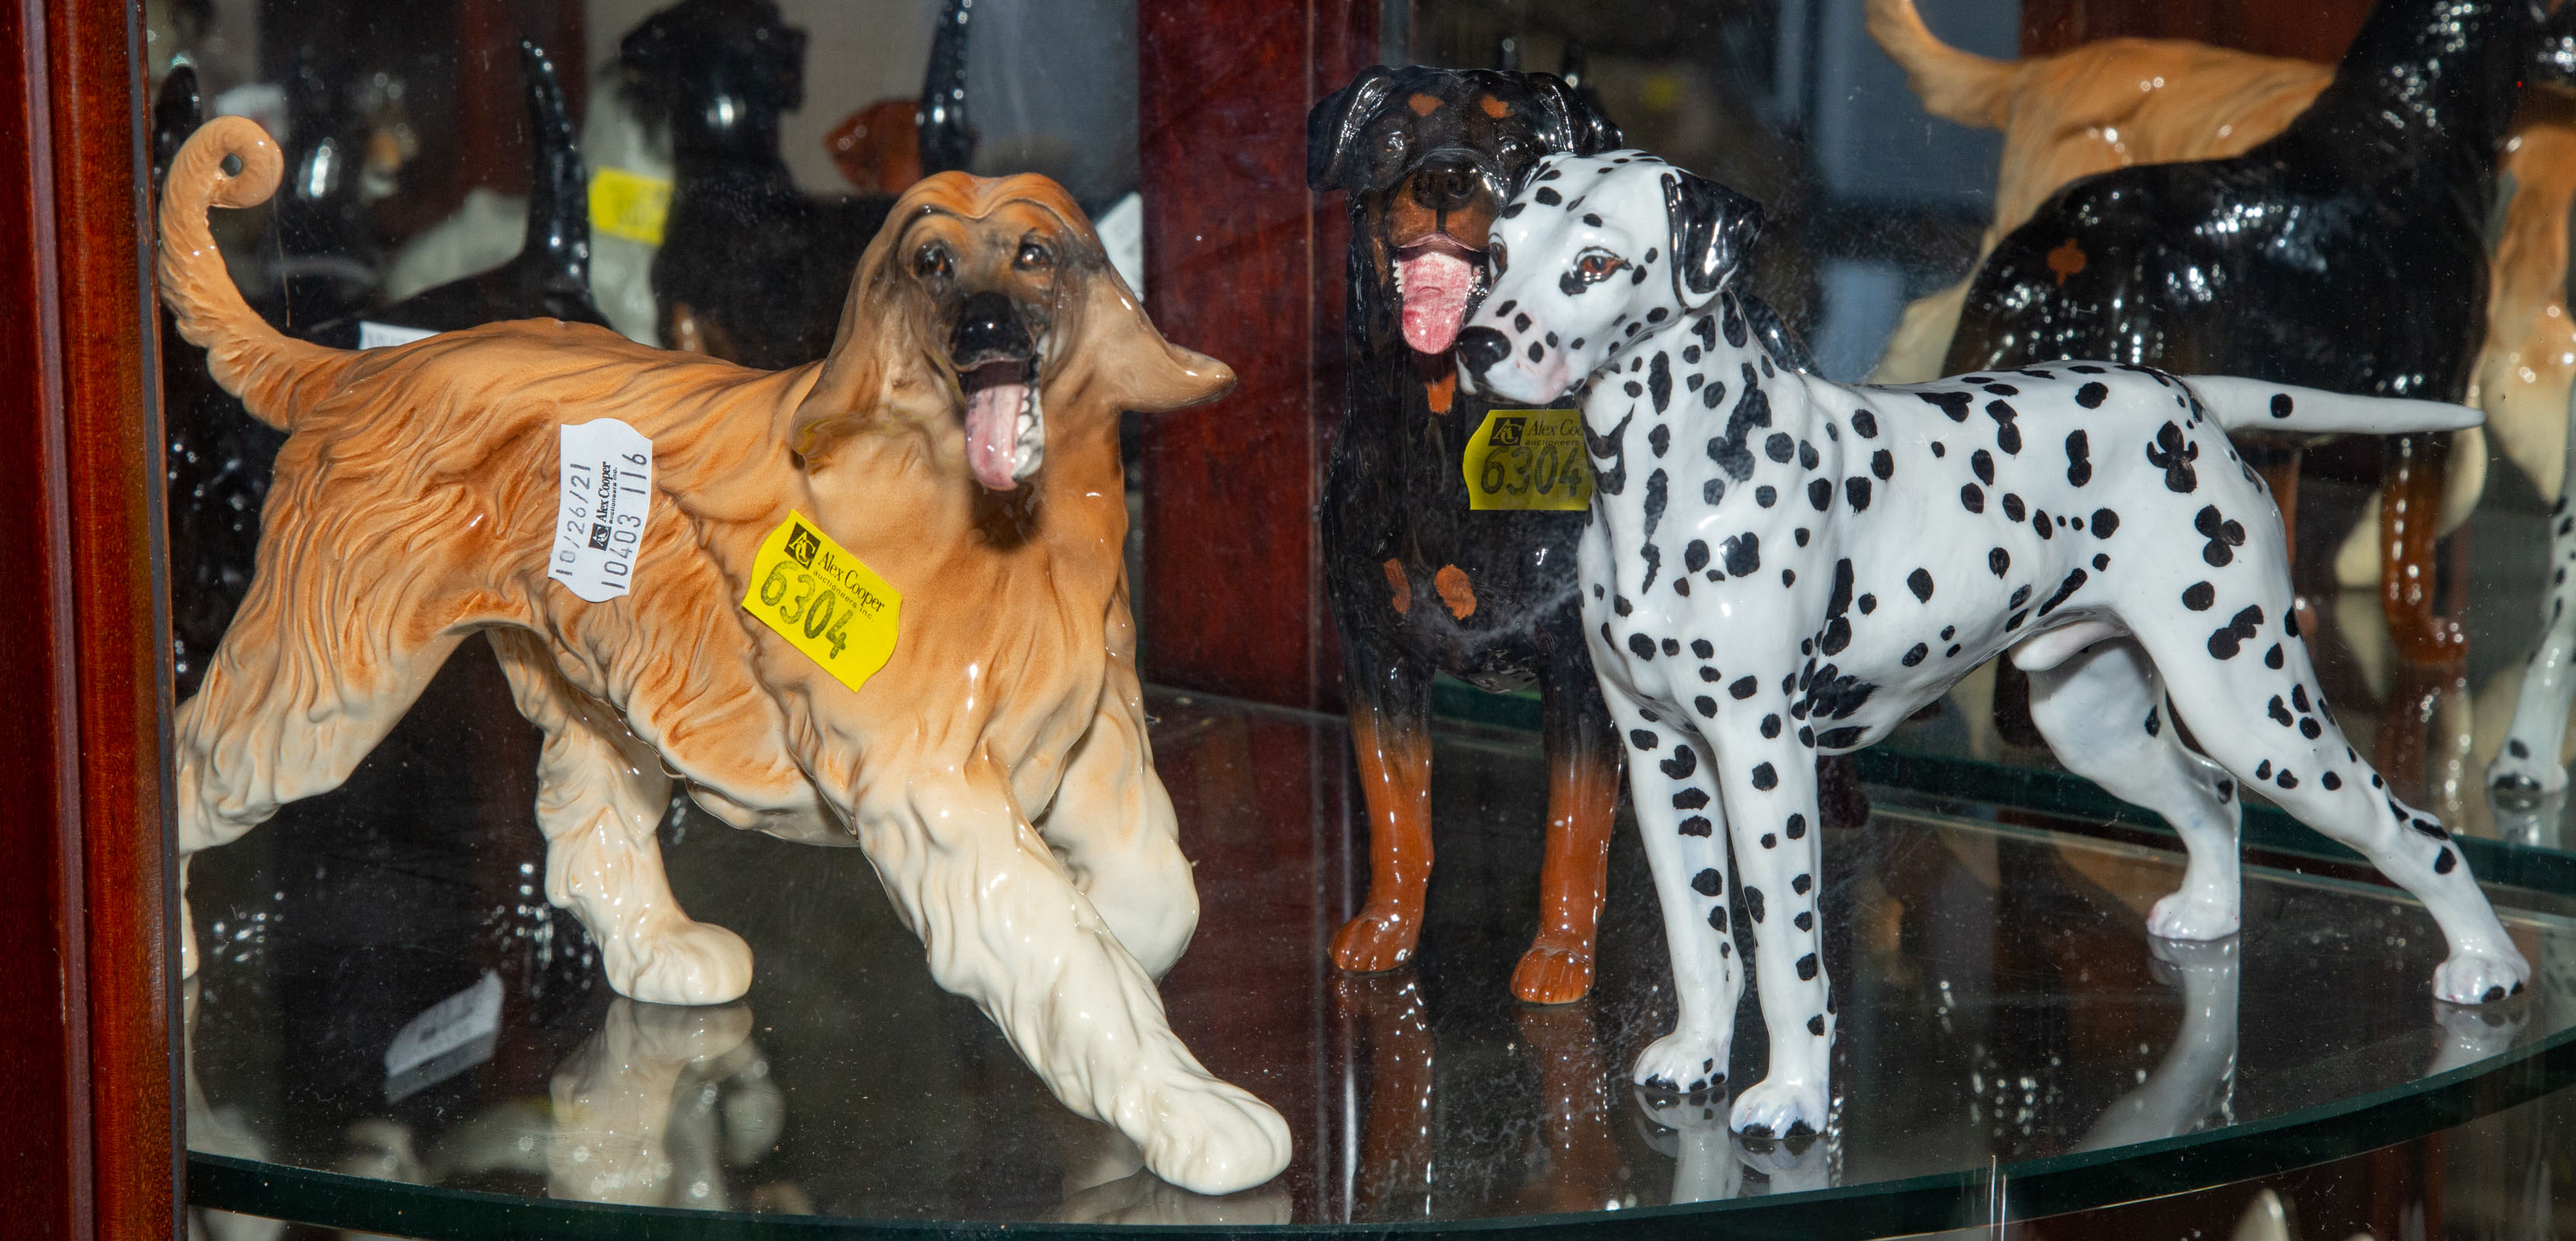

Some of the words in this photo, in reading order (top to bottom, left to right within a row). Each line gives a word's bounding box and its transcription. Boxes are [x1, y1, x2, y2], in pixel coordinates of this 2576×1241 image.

[1527, 420, 1558, 436] Alex
[597, 461, 613, 500] Cooper
[620, 454, 647, 494] 116
[1481, 446, 1582, 497] 6304
[556, 463, 591, 576] 10/26/21
[596, 500, 608, 523] Alex
[601, 514, 642, 589] 10403
[813, 570, 857, 608] auctioneers
[860, 607, 874, 621] inc.
[818, 551, 846, 581] Alex
[845, 569, 885, 613] Cooper
[760, 560, 853, 660] 6304
